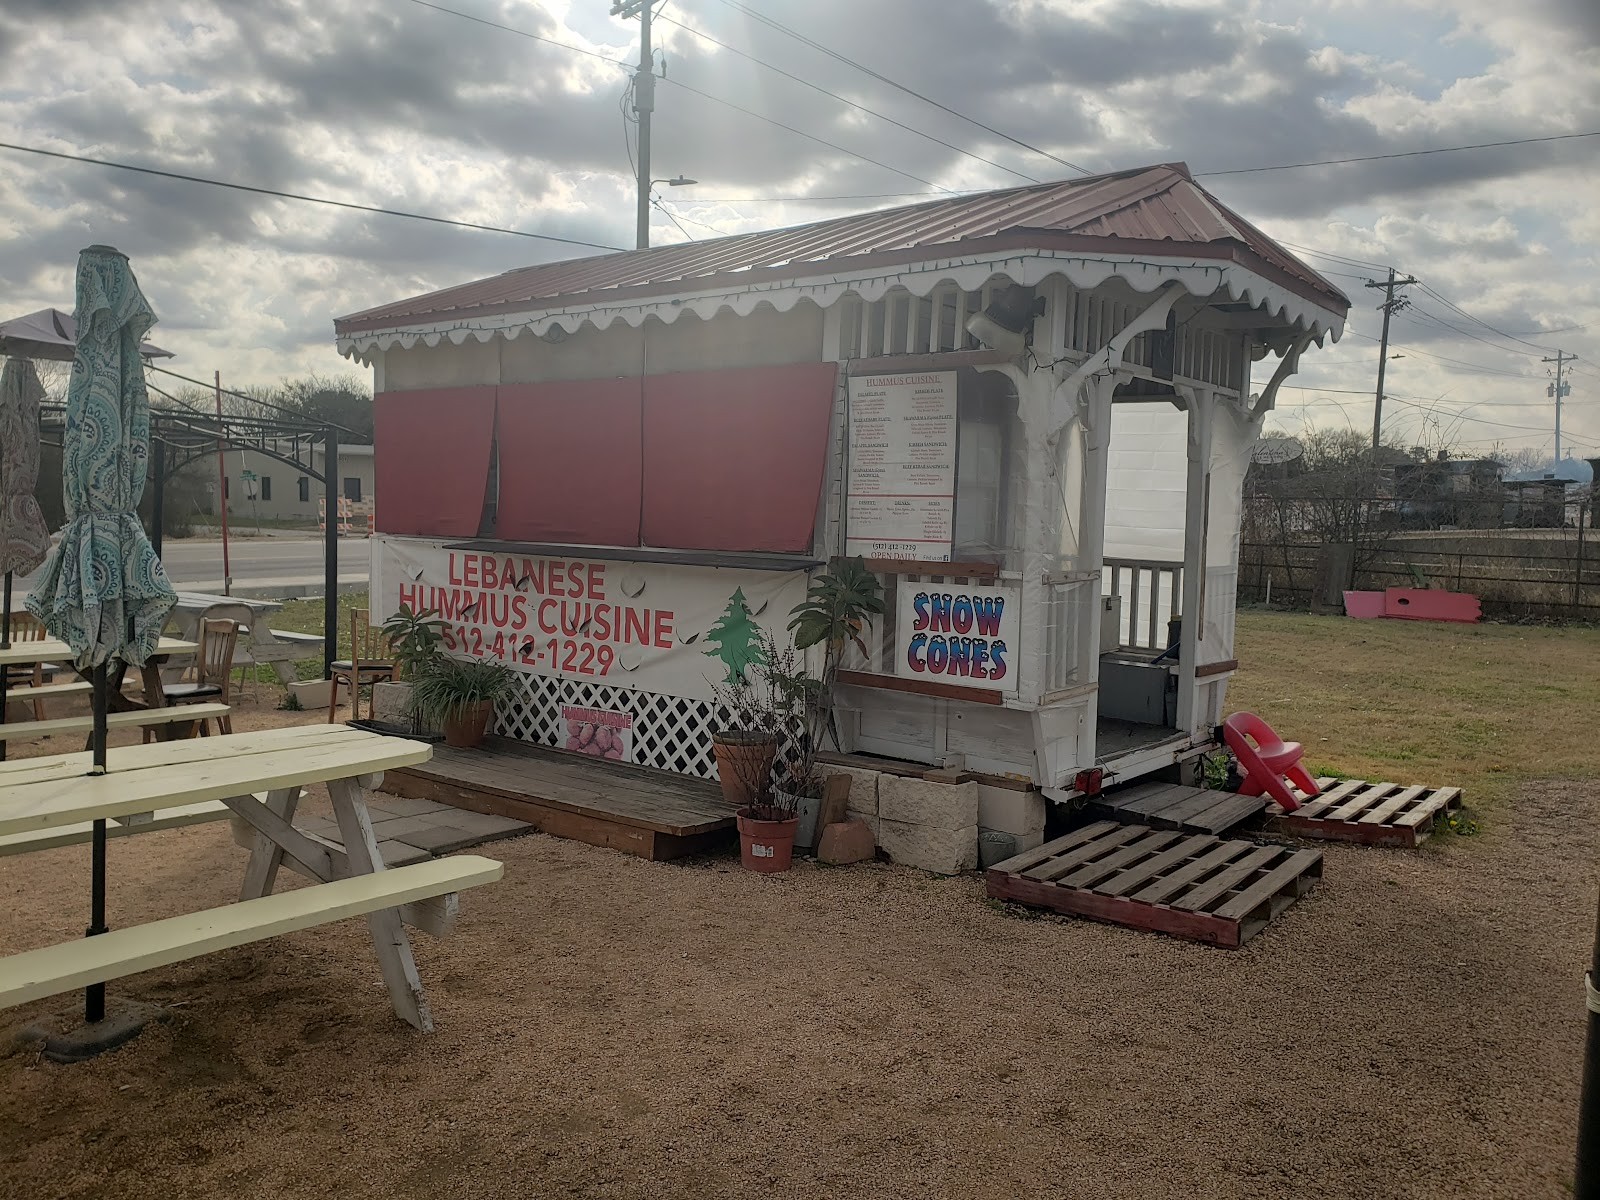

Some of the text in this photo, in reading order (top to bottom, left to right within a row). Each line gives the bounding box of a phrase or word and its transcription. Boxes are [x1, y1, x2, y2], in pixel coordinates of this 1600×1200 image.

[866, 375, 943, 387] HUMMUS CUISINE
[870, 551, 917, 561] OPEN DAILY
[872, 542, 887, 550] (512)
[888, 543, 899, 551] 412
[449, 553, 606, 600] LEBANESE
[400, 583, 674, 649] HUMMUS CUISINE
[913, 592, 1005, 637] SNOW
[441, 625, 615, 677] 512-412-1229
[908, 633, 1008, 680] CONES
[562, 705, 631, 730] HUMMUS CUISINE
